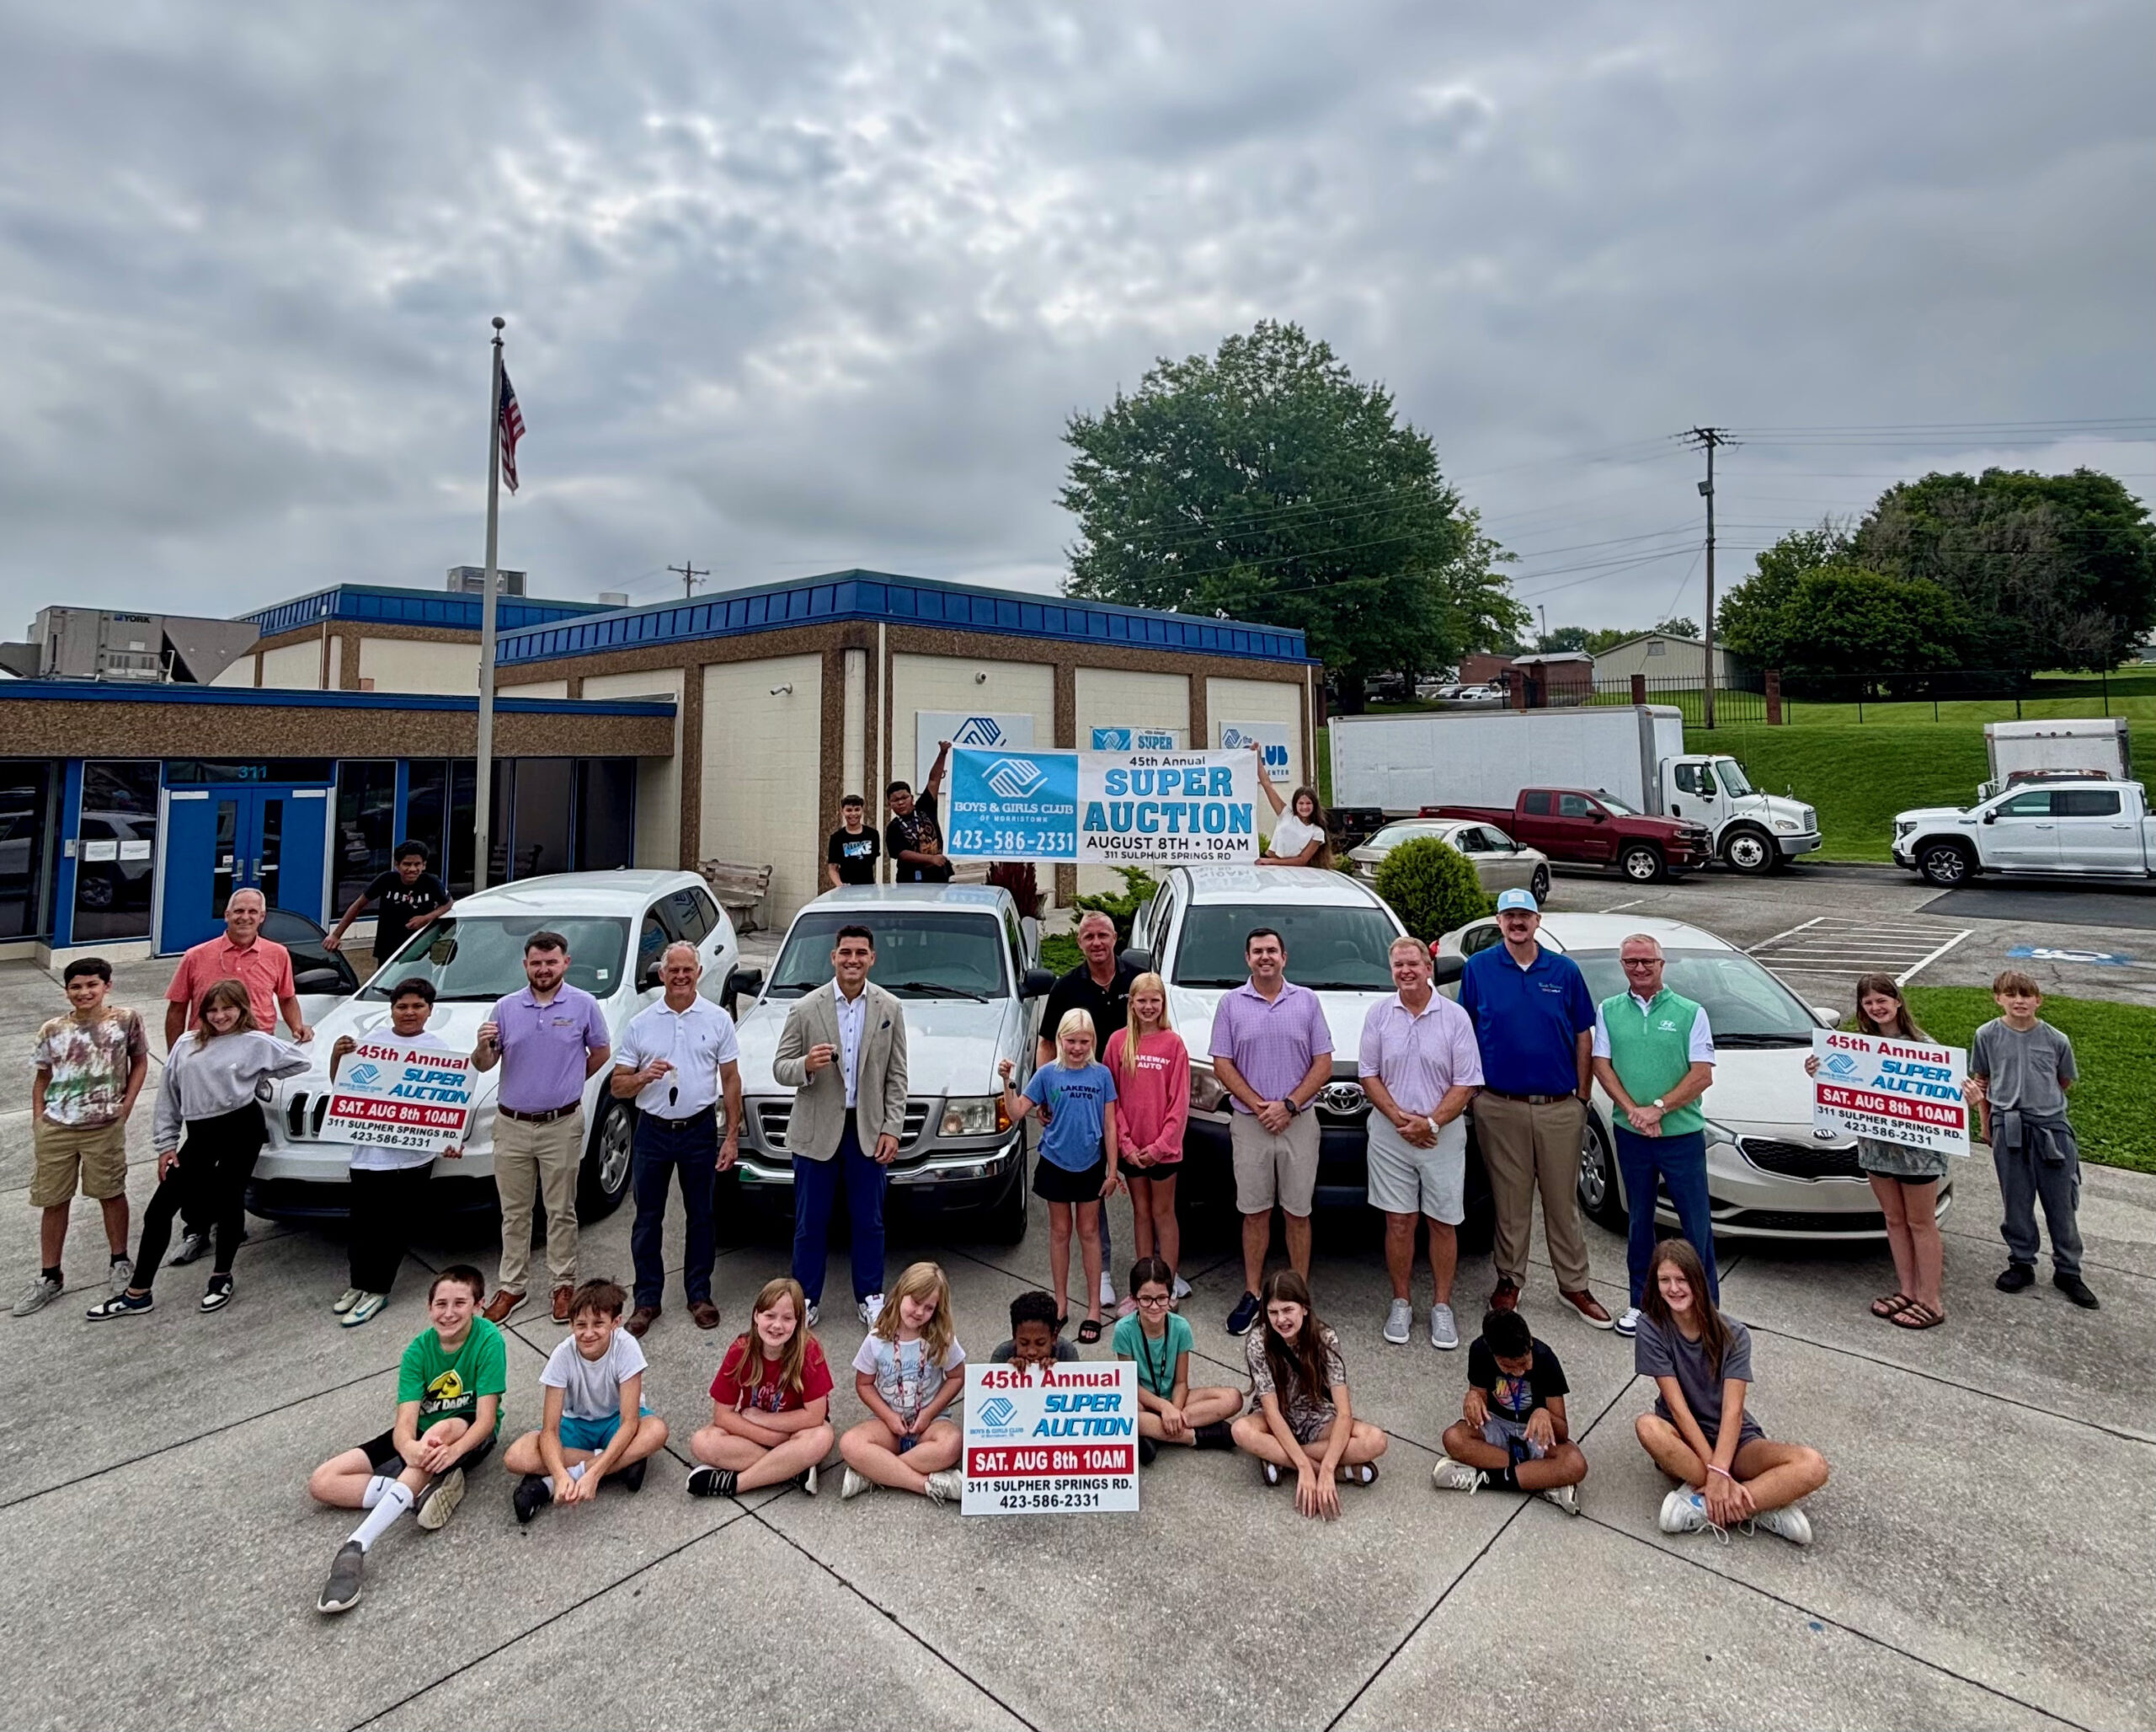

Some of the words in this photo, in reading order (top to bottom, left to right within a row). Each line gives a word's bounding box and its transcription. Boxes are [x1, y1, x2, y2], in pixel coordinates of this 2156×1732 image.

[124, 615, 151, 623] YORK
[1138, 735, 1172, 750] SUPER
[1129, 756, 1158, 767] 45th
[1162, 756, 1205, 766] Annual
[238, 766, 267, 778] 311
[1105, 767, 1232, 796] SUPER
[954, 801, 987, 812] BOYS
[990, 802, 1000, 812] &
[1002, 803, 1038, 814] GIRLS
[1041, 804, 1074, 815] CLUB
[1083, 802, 1251, 834] AUCTION
[994, 815, 1048, 823] MORRISTOWN
[952, 830, 1074, 852] 423-586-2331
[1086, 836, 1152, 849] AUGUST
[1158, 837, 1188, 850] 8TH
[1207, 838, 1249, 851] 10AM
[1104, 851, 1118, 859] 311
[1121, 851, 1167, 860] SULPHUR
[1171, 851, 1214, 860] SPRINGS
[1217, 852, 1231, 860] RD
[356, 1045, 399, 1061] 45th
[403, 1050, 470, 1070] Annual
[1826, 1034, 1870, 1052] 45th
[1876, 1042, 1951, 1065] Annual
[1134, 1055, 1171, 1066] AKEWAY
[1137, 1062, 1162, 1071] AUTO
[1881, 1059, 1952, 1082] SUPER
[403, 1067, 467, 1087] SUPER
[387, 1083, 472, 1104] AUCTION
[1060, 1084, 1102, 1094] LAKEWAY
[1069, 1092, 1093, 1100] AUTO
[1870, 1075, 1963, 1102] AUCTION
[337, 1099, 365, 1115] SAT.
[366, 1103, 397, 1119] AUG
[399, 1107, 420, 1121] 8th
[424, 1109, 459, 1125] 10AM
[1822, 1088, 1851, 1105] SAT.
[1854, 1093, 1886, 1110] AUG
[1888, 1099, 1912, 1116] 8th
[1916, 1105, 1957, 1124] 10AM
[328, 1118, 345, 1127] 311
[348, 1120, 395, 1133] SULPHER
[397, 1125, 440, 1138] SPRINGS
[442, 1130, 458, 1140] RD.
[1817, 1105, 1835, 1116] 311
[1838, 1109, 1888, 1126] SULPHER
[1891, 1119, 1940, 1136] SPRINGS
[1944, 1128, 1963, 1140] RD.
[350, 1131, 431, 1147] 423-586-2331
[1815, 1129, 1836, 1137] KIA
[1844, 1120, 1932, 1146] 423-586-2331
[981, 1371, 1033, 1389] 45th
[1040, 1369, 1120, 1388] Annual
[1044, 1393, 1122, 1413] SUPER
[1033, 1417, 1134, 1437] AUCTION
[975, 1452, 1009, 1472] SAT.
[1013, 1451, 1049, 1470] AUG
[1053, 1451, 1078, 1469] 8th
[1083, 1450, 1126, 1469] 10AM
[968, 1481, 989, 1493] 311
[993, 1479, 1050, 1492] SULPHER
[1054, 1478, 1108, 1491] SPRINGS
[1113, 1478, 1132, 1489] RD.
[1000, 1494, 1099, 1509] 423-586-2331
